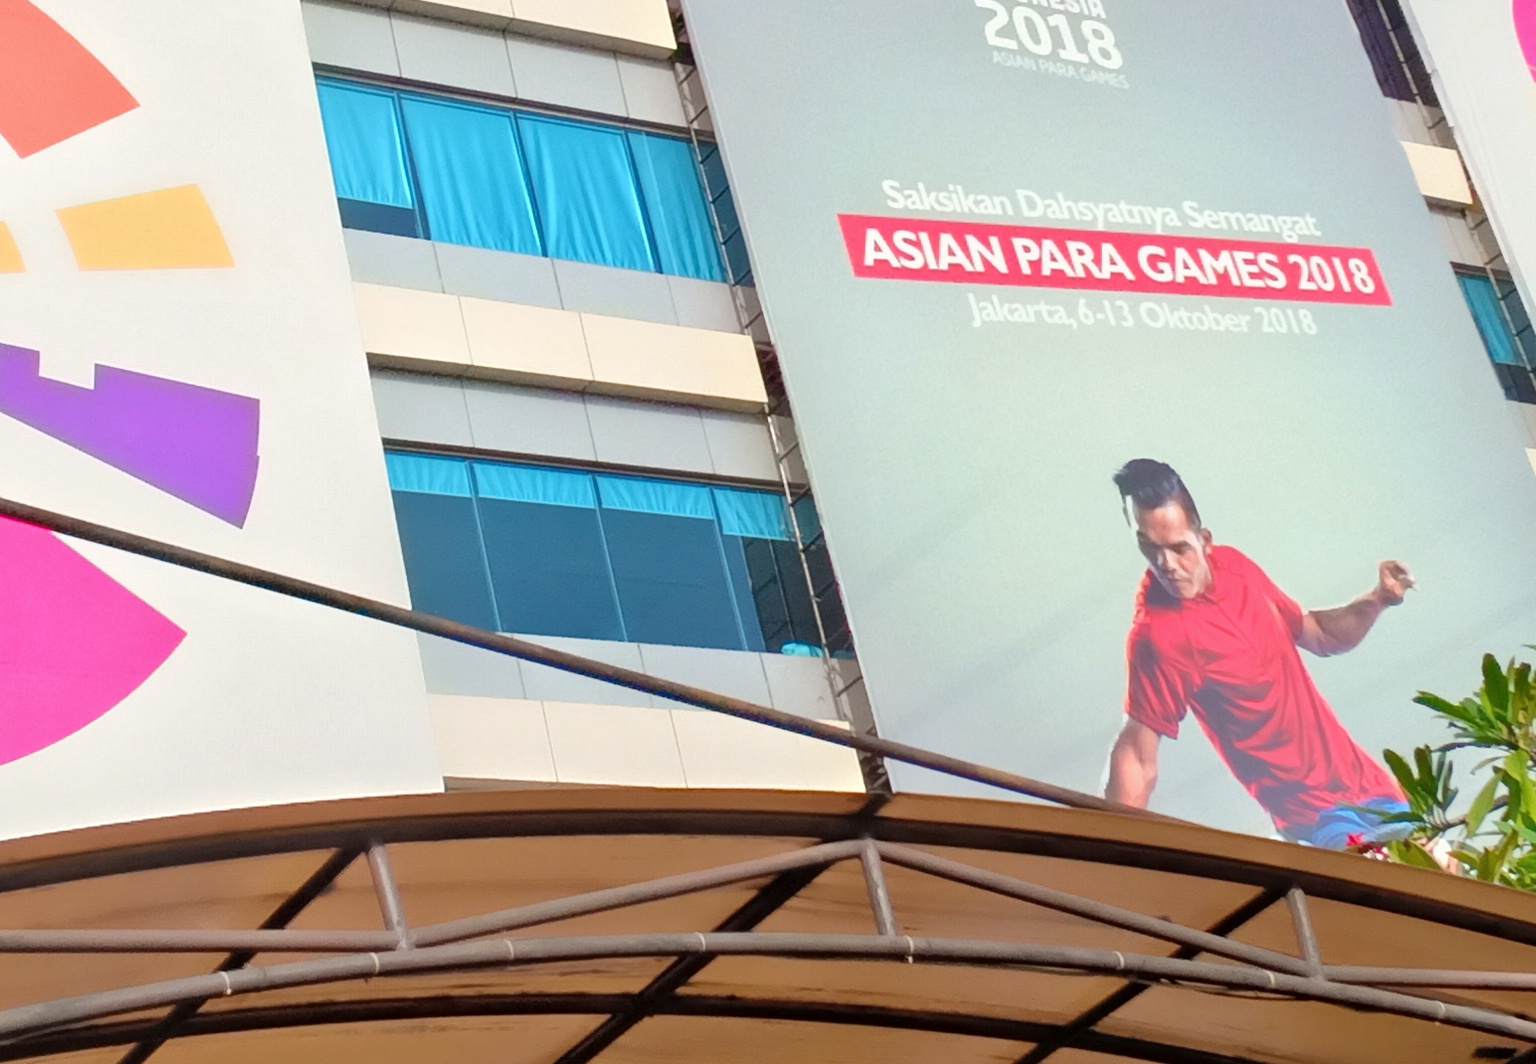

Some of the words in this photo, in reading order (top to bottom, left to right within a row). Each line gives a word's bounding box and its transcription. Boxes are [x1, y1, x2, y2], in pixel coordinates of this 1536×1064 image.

[992, 50, 1037, 72] ASIAN
[1038, 58, 1080, 79] PARA
[1079, 67, 1130, 89] GAMES
[882, 179, 1013, 216] Saksikan
[1018, 188, 1180, 232] Dahsyatnya
[1183, 200, 1321, 242] Semangat
[864, 228, 1009, 274] ASIAN
[1012, 236, 1134, 280] PARA
[1138, 245, 1286, 289] GAMES
[1289, 254, 1376, 295] 2018
[968, 293, 1077, 329] Jakarta,
[1078, 298, 1135, 327] 6-13
[1140, 301, 1251, 332] Oktober
[1254, 306, 1317, 335] 2018
